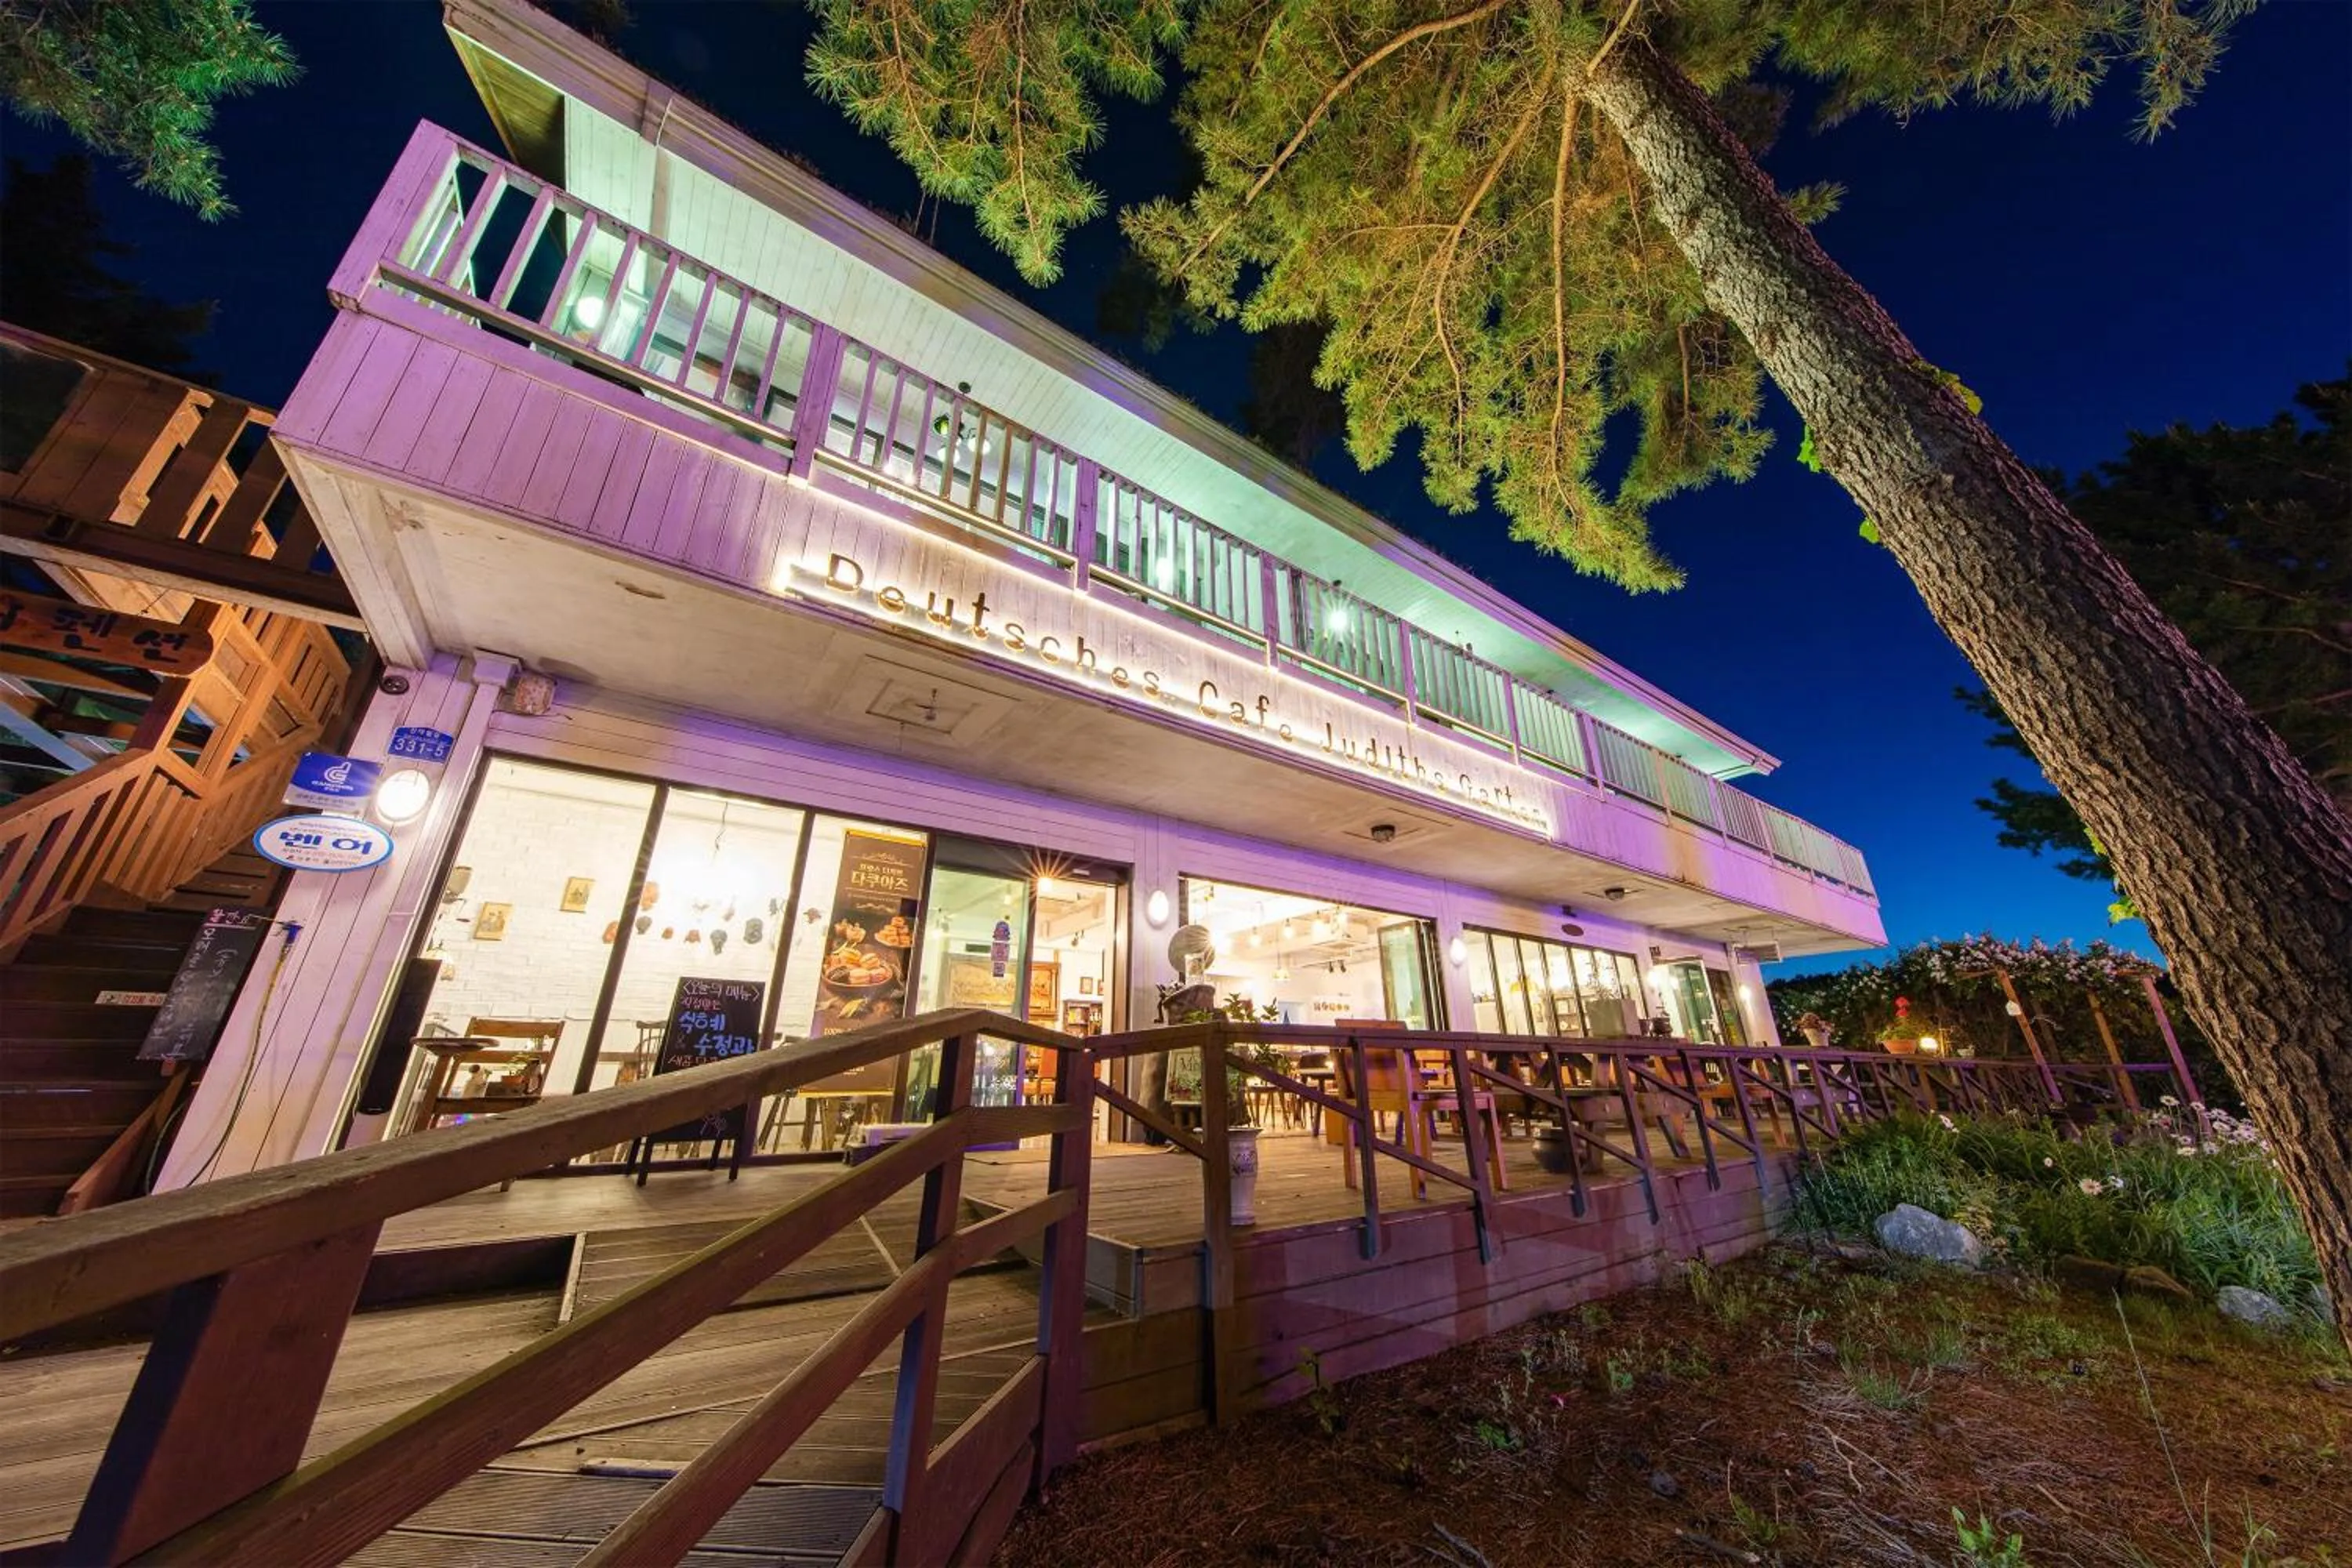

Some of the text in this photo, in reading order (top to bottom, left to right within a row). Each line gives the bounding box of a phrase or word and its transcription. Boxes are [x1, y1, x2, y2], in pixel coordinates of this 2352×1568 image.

[826, 553, 1160, 696] Deutsches
[1199, 680, 1293, 742] Cafe
[851, 871, 909, 891] 다쿠아즈
[694, 1033, 755, 1056] 수정과
